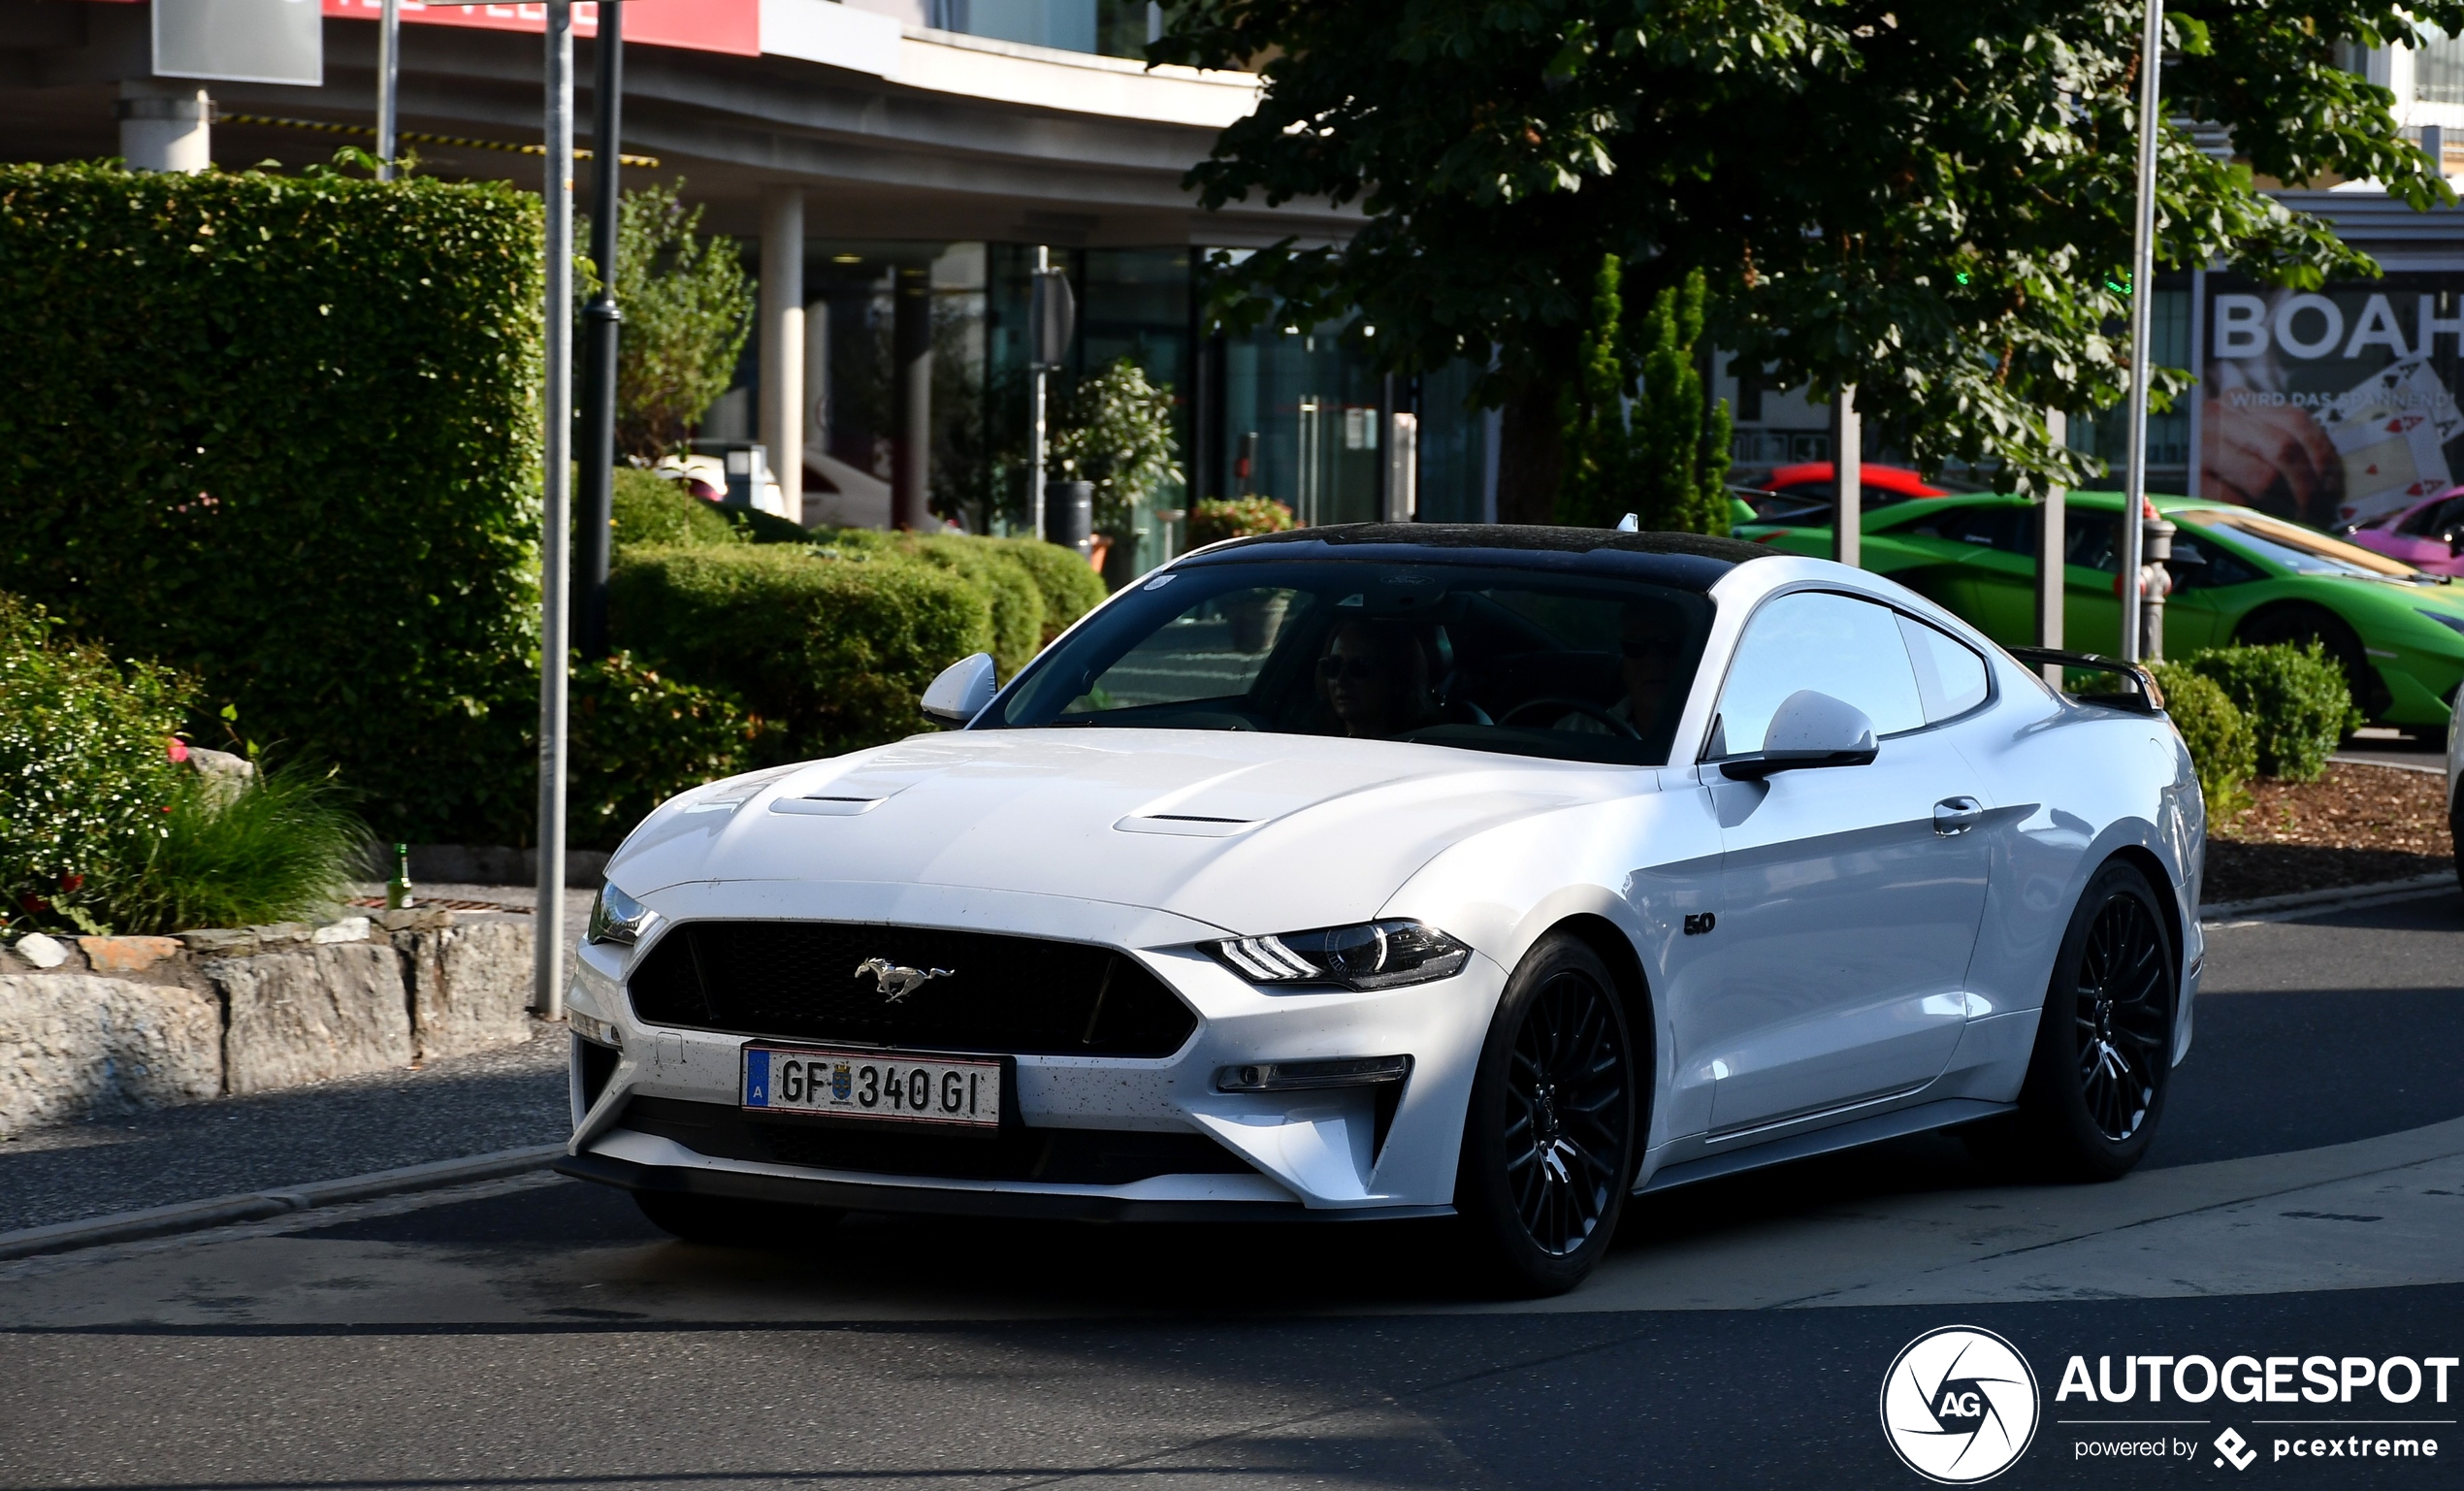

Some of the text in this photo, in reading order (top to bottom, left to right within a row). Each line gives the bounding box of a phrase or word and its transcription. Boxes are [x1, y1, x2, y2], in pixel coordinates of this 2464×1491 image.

[2213, 293, 2464, 359] BOAH
[2230, 392, 2286, 407] WIRD
[2291, 392, 2331, 407] DAS
[752, 1086, 763, 1099] A
[782, 1059, 976, 1115] GF 340 GI
